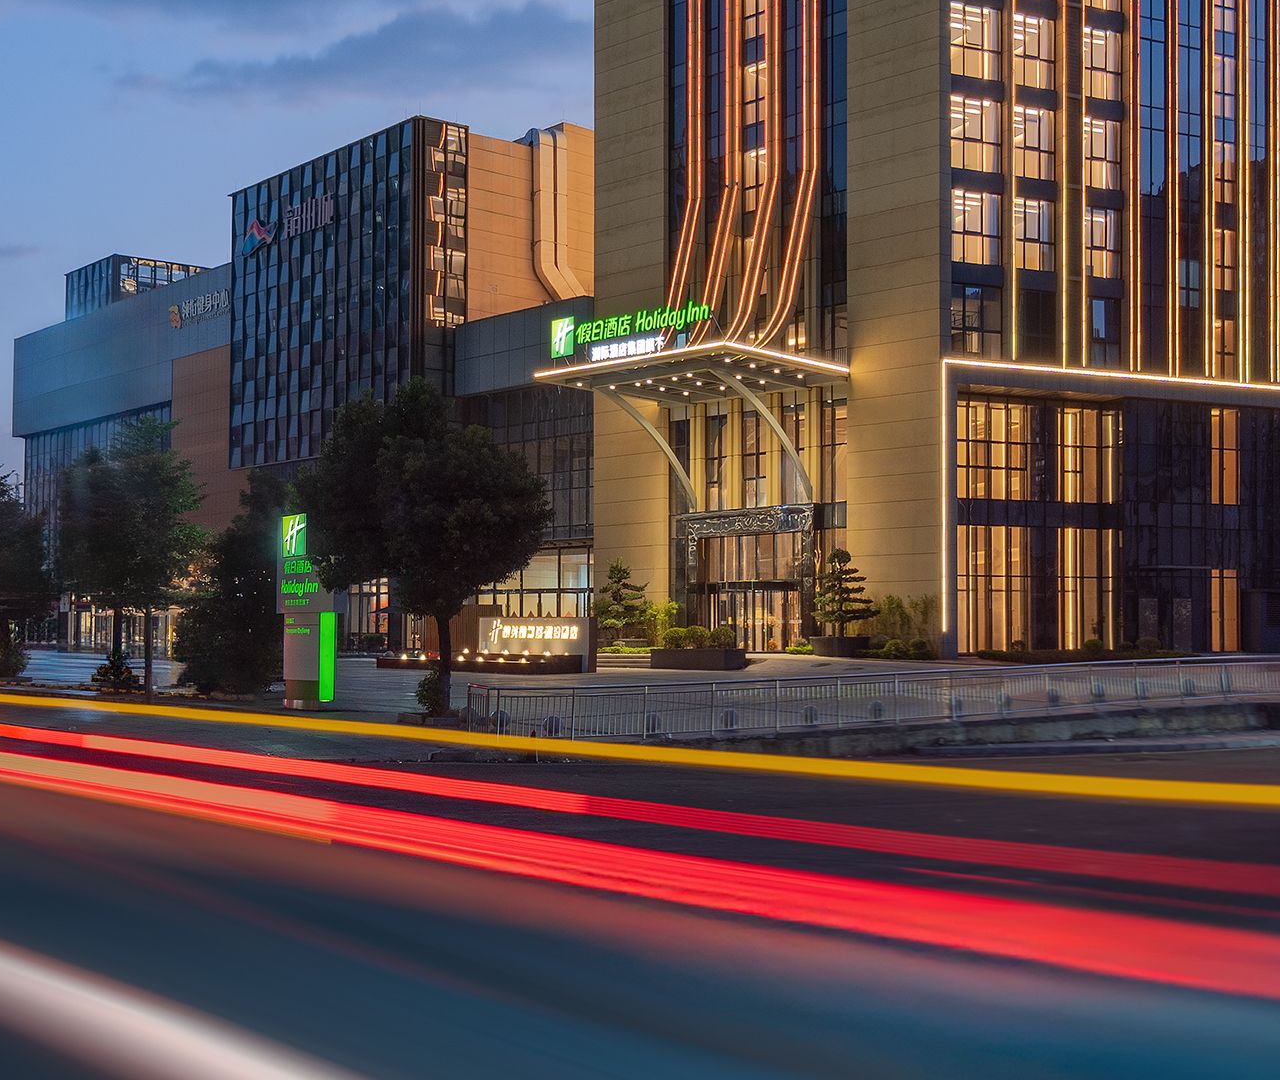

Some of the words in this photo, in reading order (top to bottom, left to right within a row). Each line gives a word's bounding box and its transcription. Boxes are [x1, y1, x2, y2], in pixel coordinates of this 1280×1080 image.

[634, 306, 686, 331] Holiday
[686, 300, 710, 324] Inn
[575, 314, 632, 345] 假日酒店
[284, 559, 313, 574] 假日酒店
[280, 578, 305, 597] Holiday
[304, 577, 319, 593] Inn
